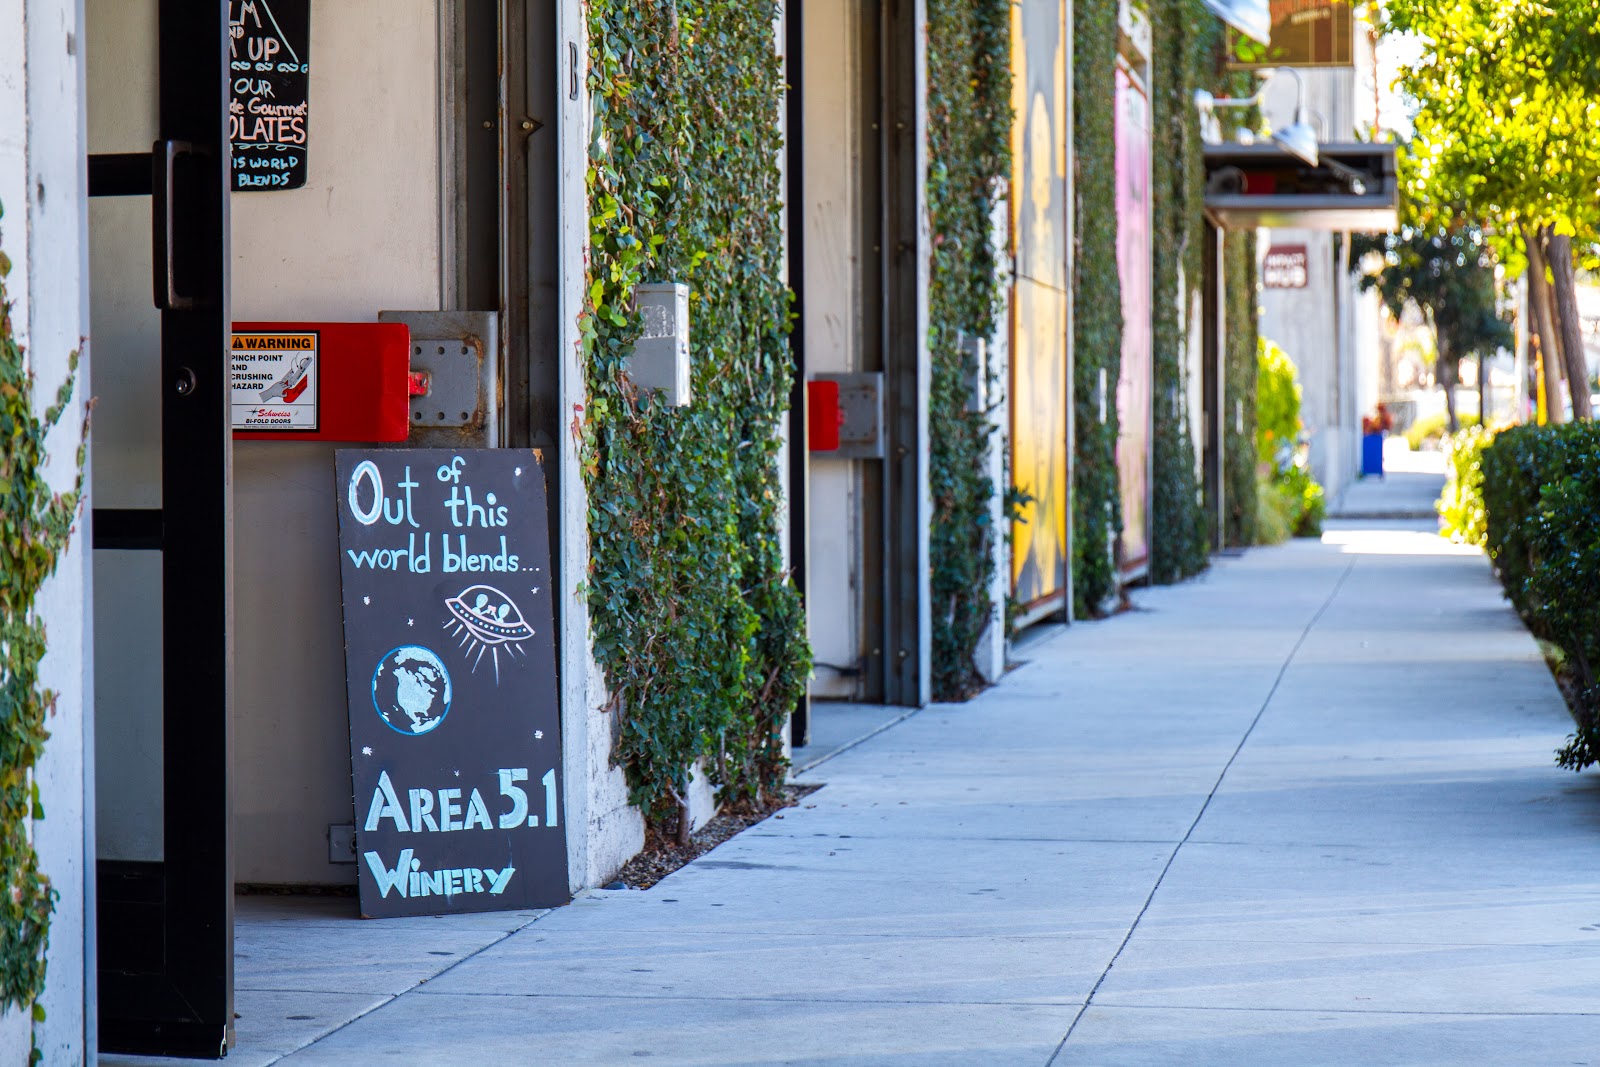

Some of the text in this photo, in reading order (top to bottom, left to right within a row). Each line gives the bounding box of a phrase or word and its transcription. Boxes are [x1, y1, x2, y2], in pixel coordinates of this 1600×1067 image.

[248, 36, 280, 61] UP
[234, 78, 275, 98] OUR
[247, 97, 307, 116] Gourmet
[249, 156, 298, 169] WORLD
[238, 172, 290, 187] BLENDS
[245, 338, 311, 349] WARNING
[257, 408, 291, 417] Schweiss
[348, 455, 466, 528] Out of
[444, 486, 508, 528] this
[347, 532, 431, 574] world
[364, 768, 558, 833] AREA 5.1
